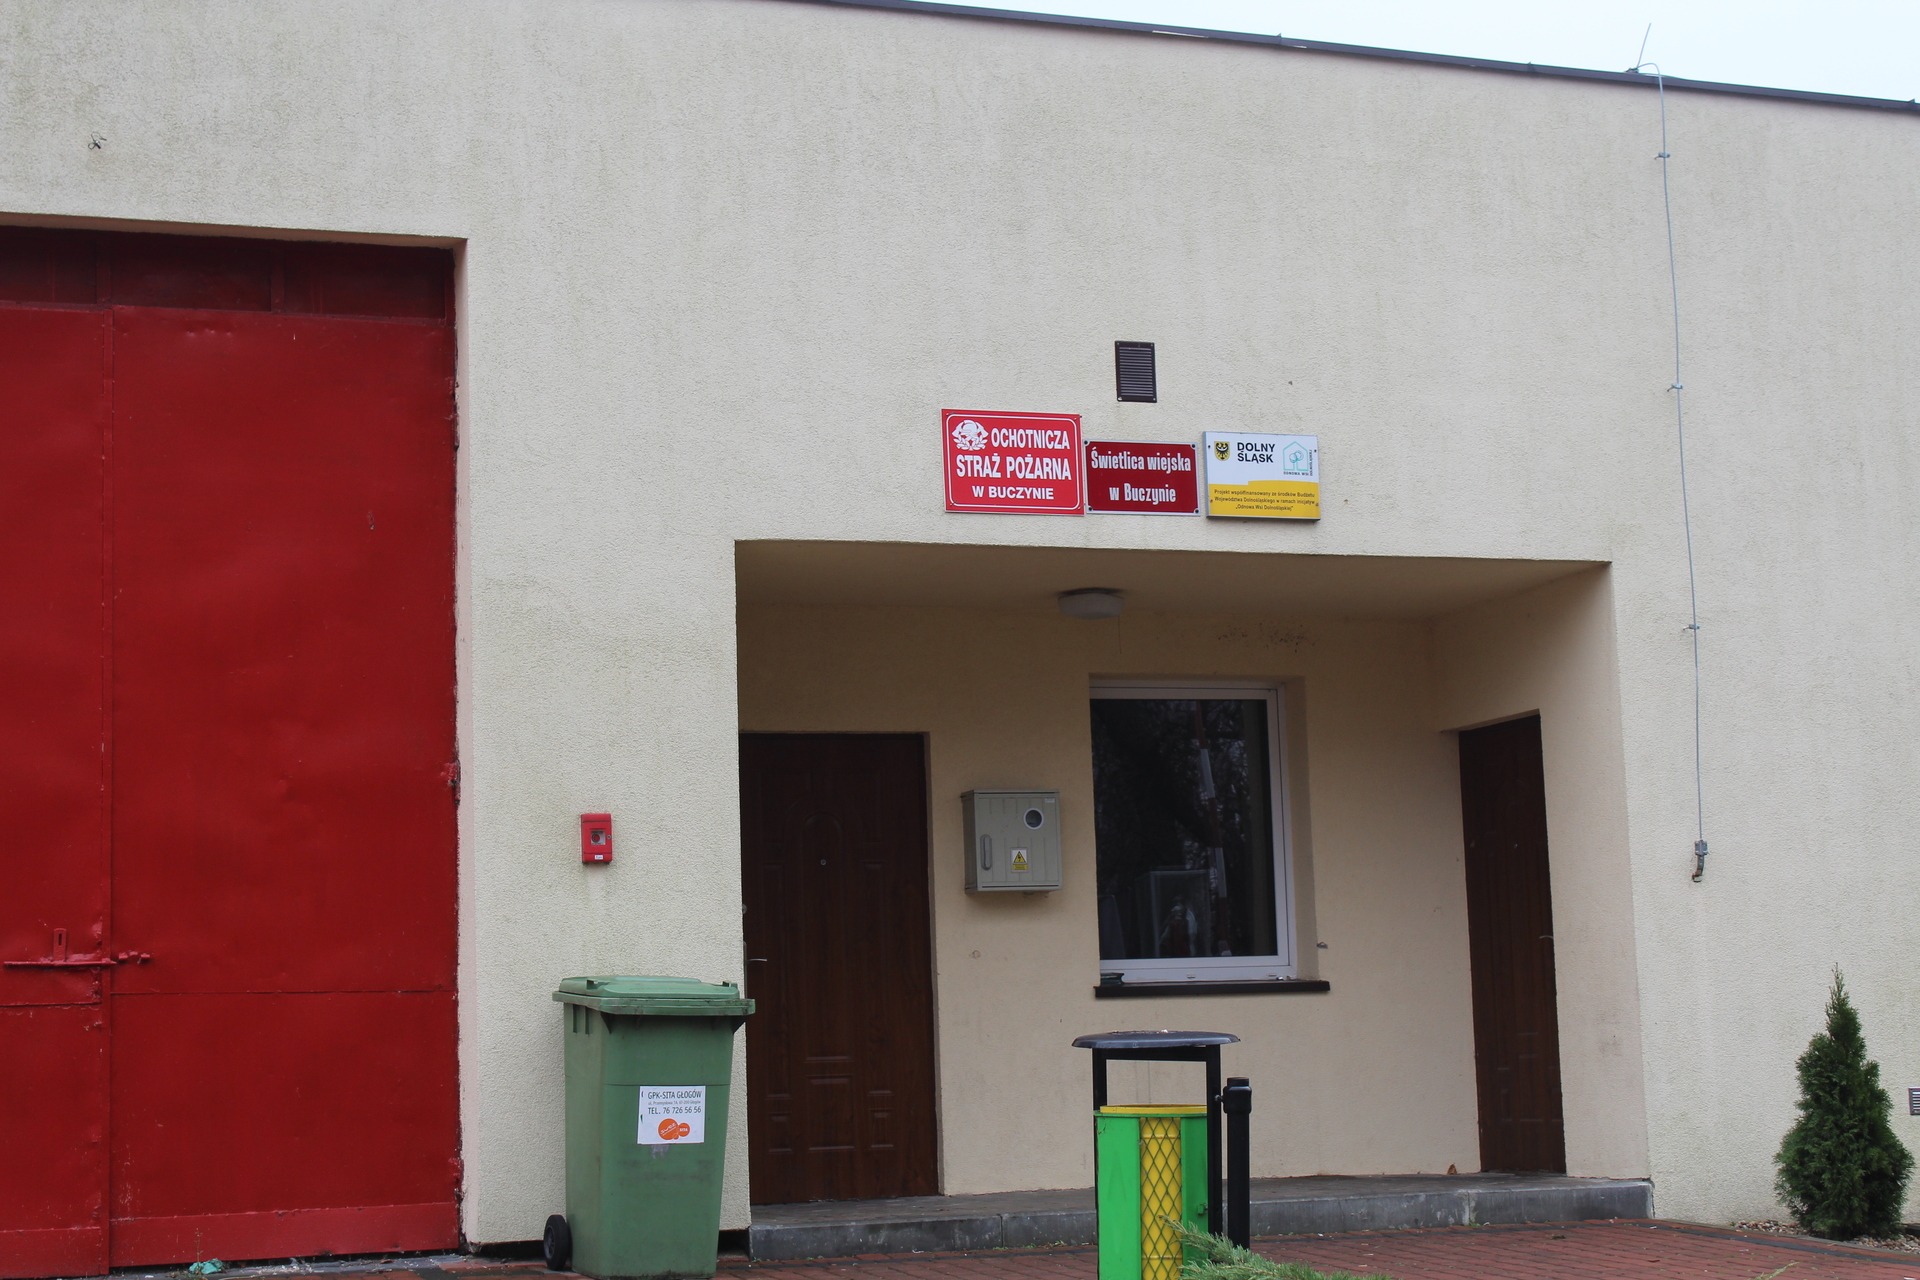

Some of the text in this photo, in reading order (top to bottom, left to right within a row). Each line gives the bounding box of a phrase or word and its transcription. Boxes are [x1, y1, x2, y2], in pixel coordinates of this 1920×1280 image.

[991, 428, 1070, 449] OCHOTNICZA
[1237, 442, 1275, 452] DOLNY
[1091, 446, 1191, 474] Świetlica wiejska
[1237, 451, 1274, 464] ŚLĄSK
[956, 453, 1072, 480] STRAŻ POŻARNA
[972, 485, 1054, 500] W BUCZYNIE
[1109, 483, 1176, 505] w Buczynie
[648, 1089, 702, 1099] GPK-SITA GŁOGÓW
[672, 1106, 683, 1114] 726
